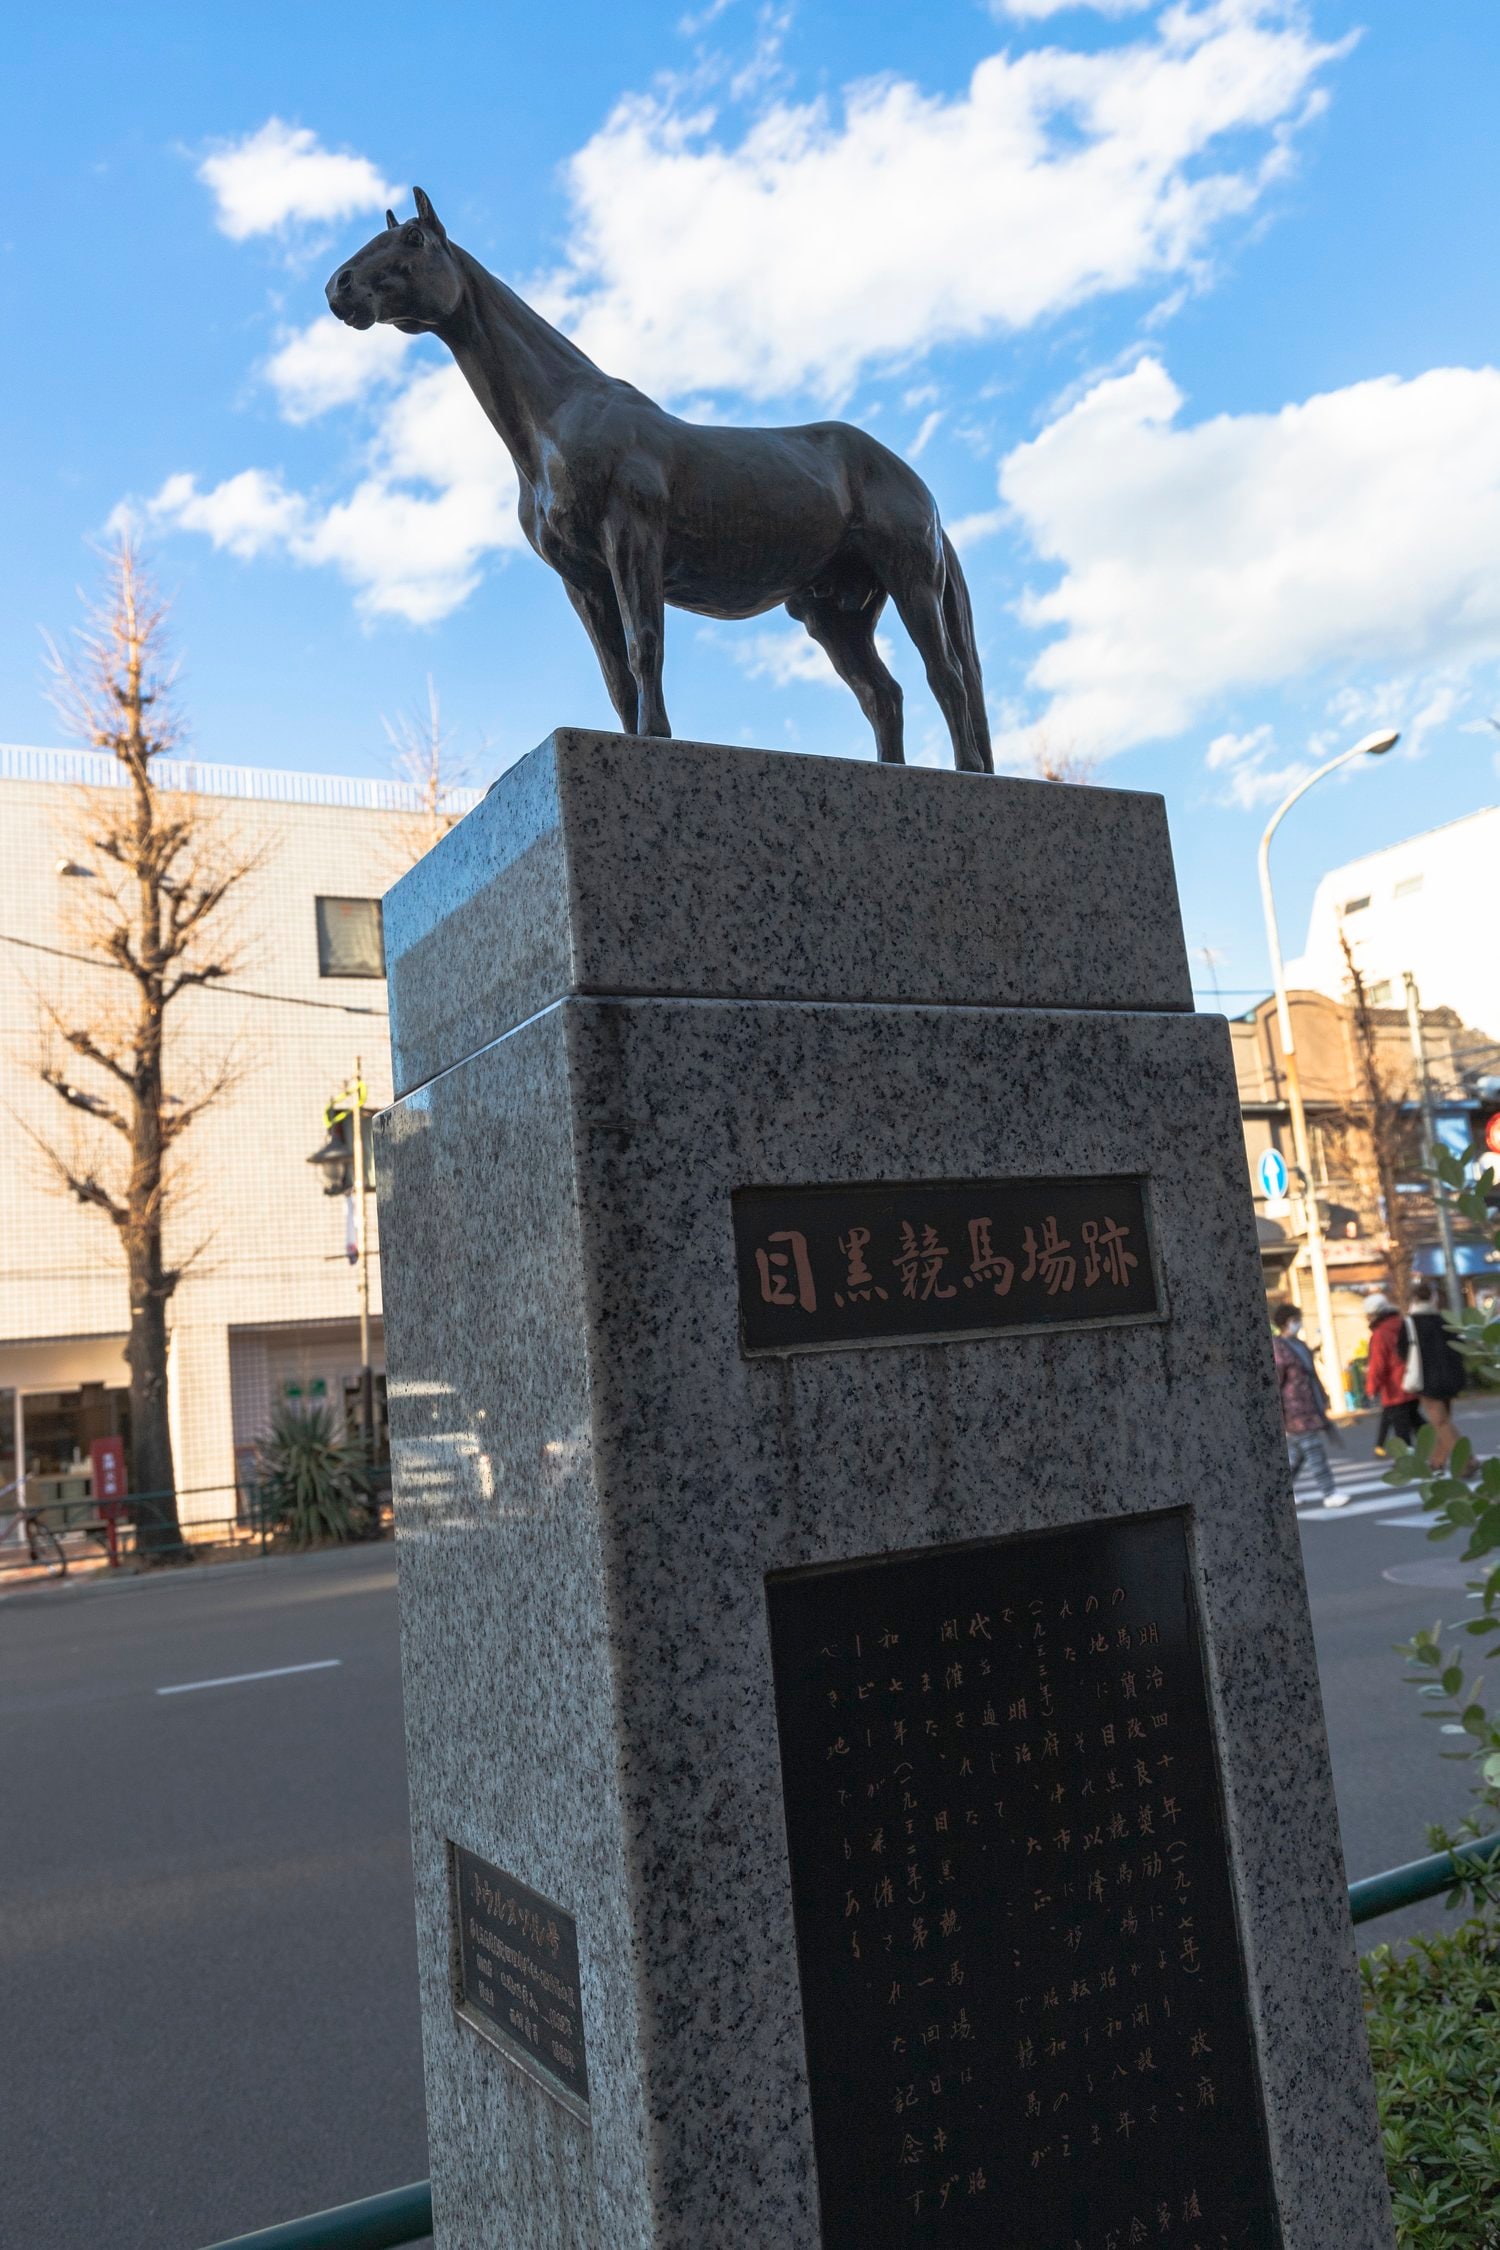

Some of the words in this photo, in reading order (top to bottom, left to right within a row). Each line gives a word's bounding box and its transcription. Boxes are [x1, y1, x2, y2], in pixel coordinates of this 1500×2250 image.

[755, 1216, 1138, 1314] 目黒競馬場跡
